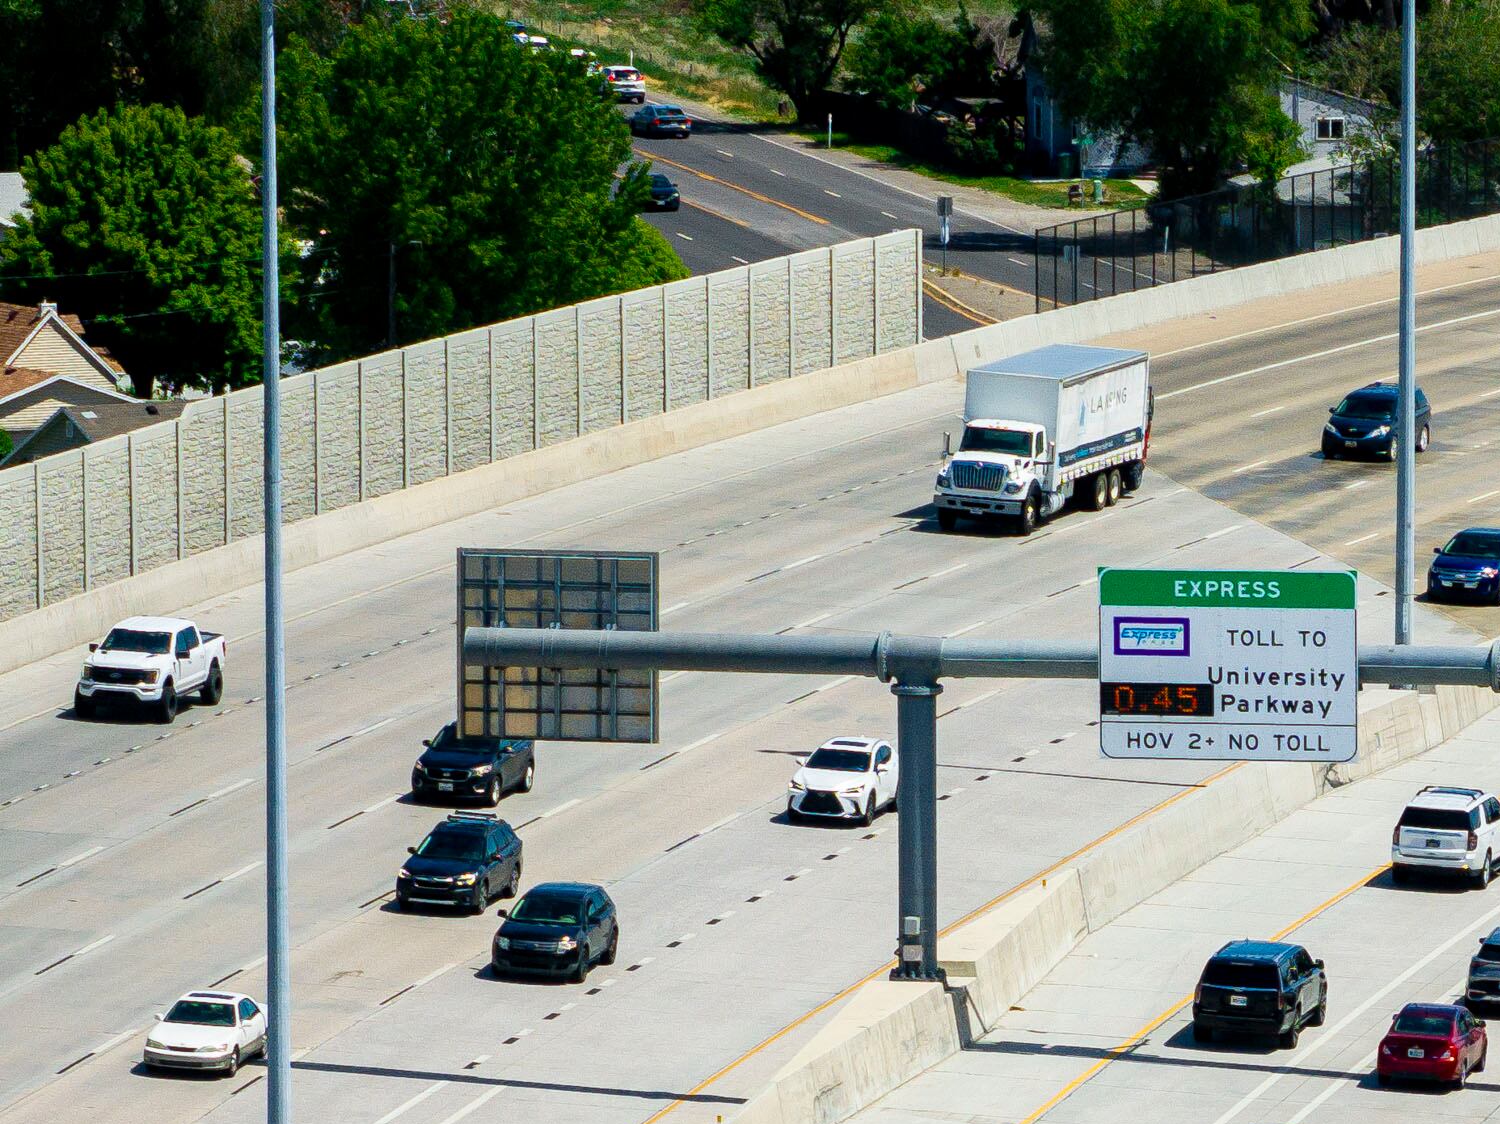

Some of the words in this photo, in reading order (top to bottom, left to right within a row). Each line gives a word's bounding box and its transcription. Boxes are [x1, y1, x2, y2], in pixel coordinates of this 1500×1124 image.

[1174, 580, 1281, 598] EXPRESS
[1121, 627, 1179, 646] Express
[1227, 630, 1284, 647] TOLL
[1298, 630, 1327, 647] TO
[1207, 666, 1346, 692] University
[1114, 686, 1198, 713] 0.45
[1220, 694, 1332, 718] Parkway
[1127, 732, 1174, 749] HOV
[1188, 733, 1215, 750] 2+
[1229, 734, 1259, 750] NO
[1273, 734, 1331, 752] TOLL
